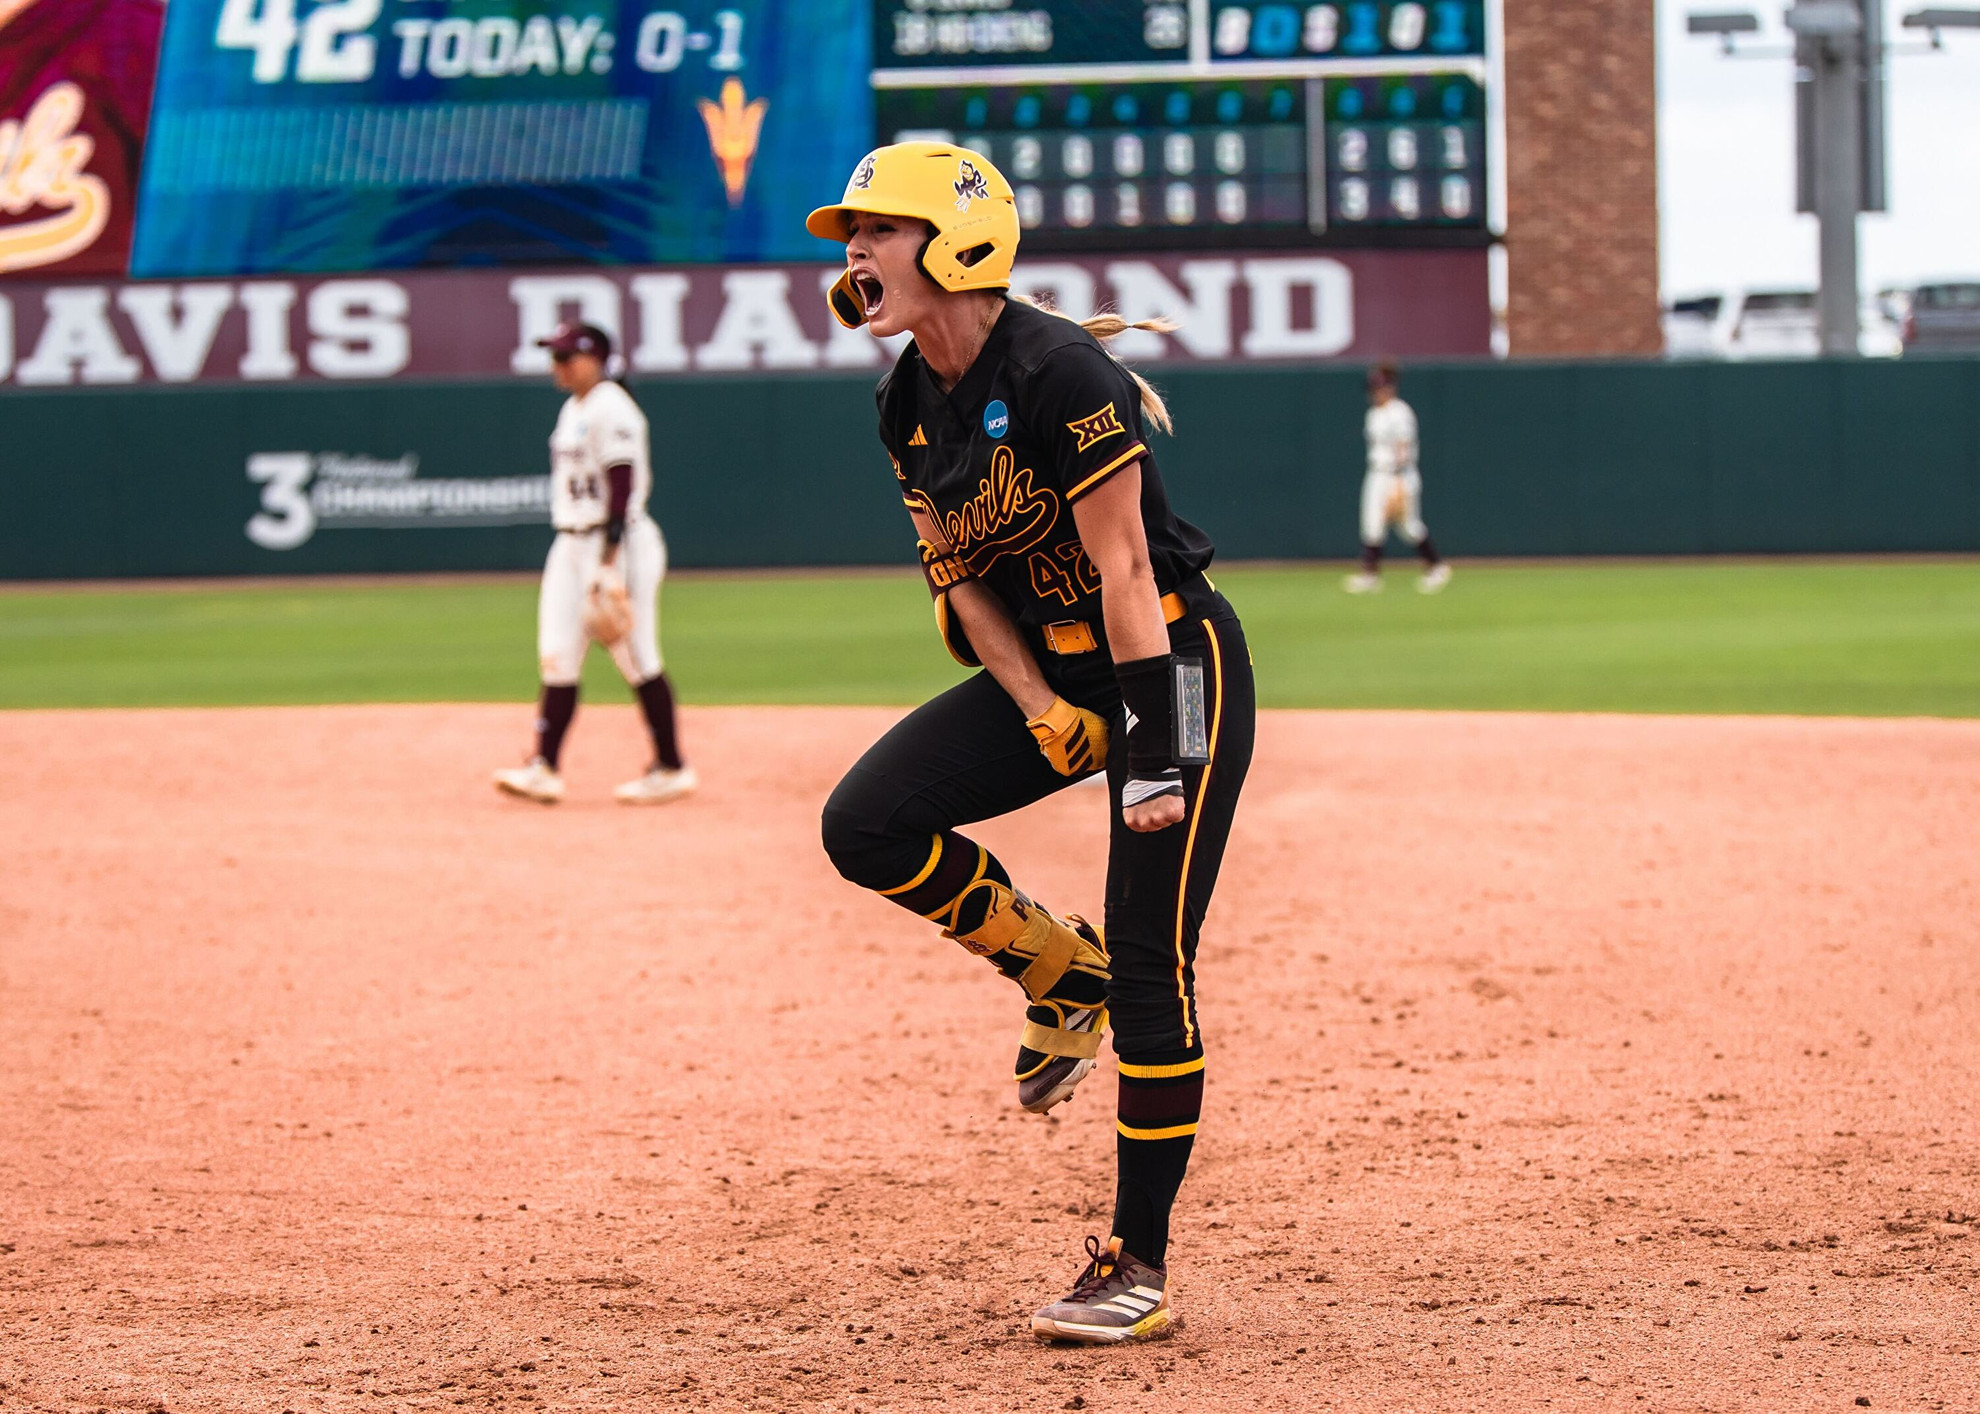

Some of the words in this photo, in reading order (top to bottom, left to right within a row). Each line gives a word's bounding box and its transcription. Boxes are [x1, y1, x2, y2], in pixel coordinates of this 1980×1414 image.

[215, 0, 382, 83] 42
[393, 14, 614, 79] TODAY:
[635, 10, 745, 73] 0-1
[0, 278, 411, 386] AVIS
[508, 256, 1355, 375] DIAND
[987, 415, 1008, 431] NCAA
[246, 450, 317, 550] 3
[1028, 540, 1104, 606] 42
